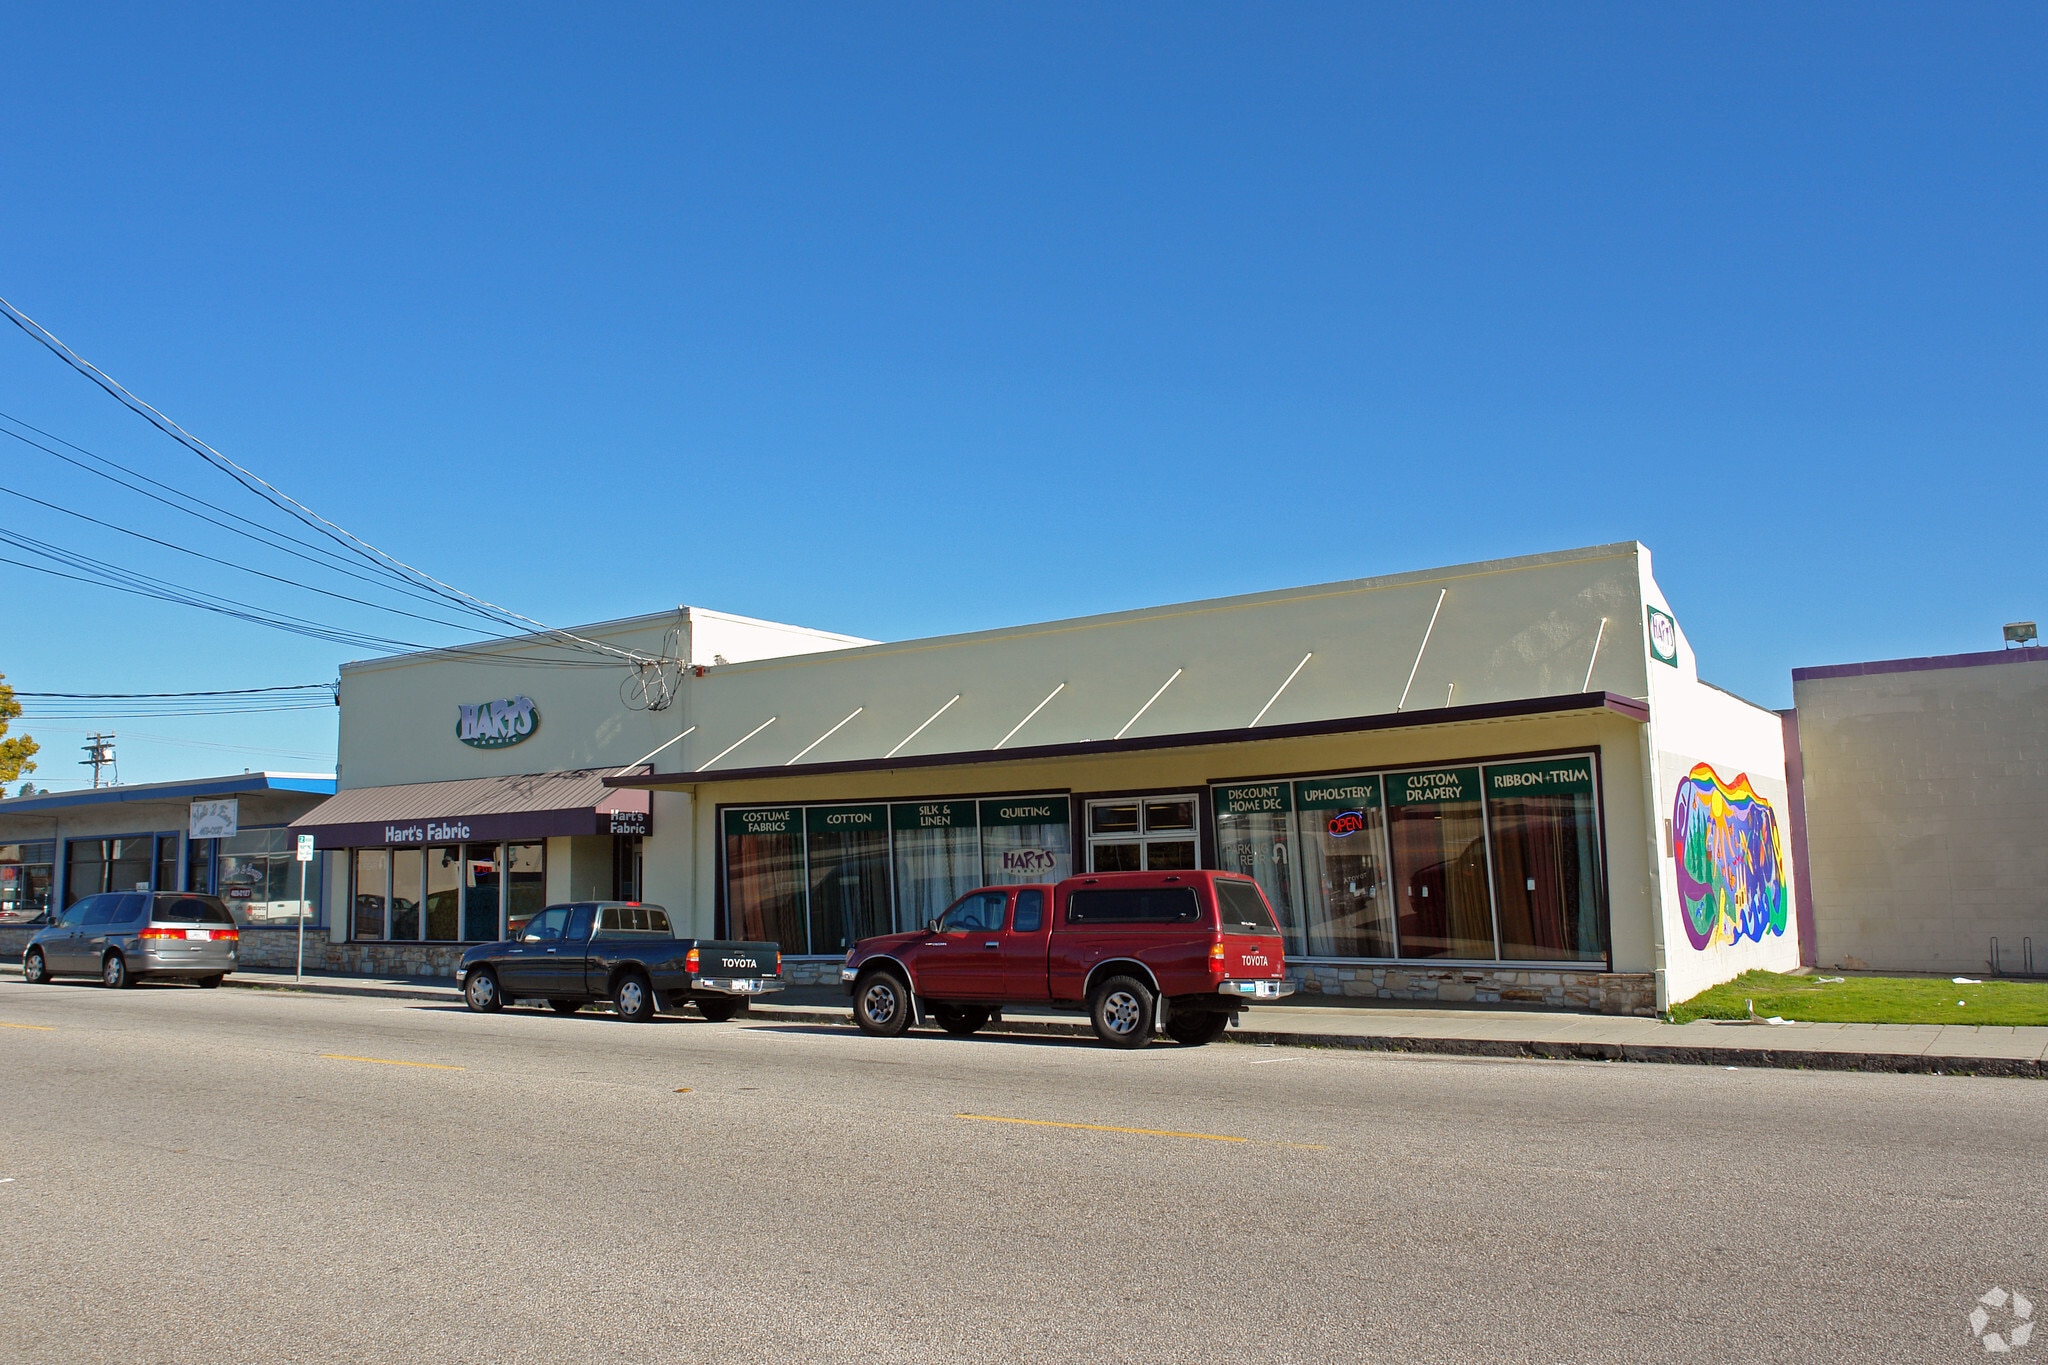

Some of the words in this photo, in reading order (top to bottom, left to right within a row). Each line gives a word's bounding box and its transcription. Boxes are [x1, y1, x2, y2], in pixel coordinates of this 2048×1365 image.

[1407, 773, 1459, 788] CUSTOM
[1494, 771, 1543, 788] RIBBON
[1550, 769, 1589, 783] TRIM
[1228, 786, 1279, 800] DISCOUNT
[1304, 785, 1373, 801] UPHOLSTERY
[1406, 786, 1463, 801] DRAPERY
[919, 805, 939, 815] SILK
[943, 804, 950, 814] &
[1229, 800, 1260, 812] HOME
[1263, 799, 1282, 810] DEC
[610, 809, 644, 821] Hart's
[742, 811, 790, 822] COSTUME
[827, 813, 872, 824] COTTON
[1000, 806, 1050, 819] QUILTING
[748, 822, 786, 832] FABRICS
[920, 816, 950, 826] LINEN
[1328, 816, 1363, 834] OPEN
[385, 825, 423, 842] Hart's
[427, 822, 470, 840] Fabric
[610, 822, 646, 834] Fabric
[1225, 843, 1269, 855] PARKING
[1240, 855, 1266, 866] REAR
[722, 958, 757, 968] TOYOTA
[1241, 955, 1268, 967] TOYOTA
